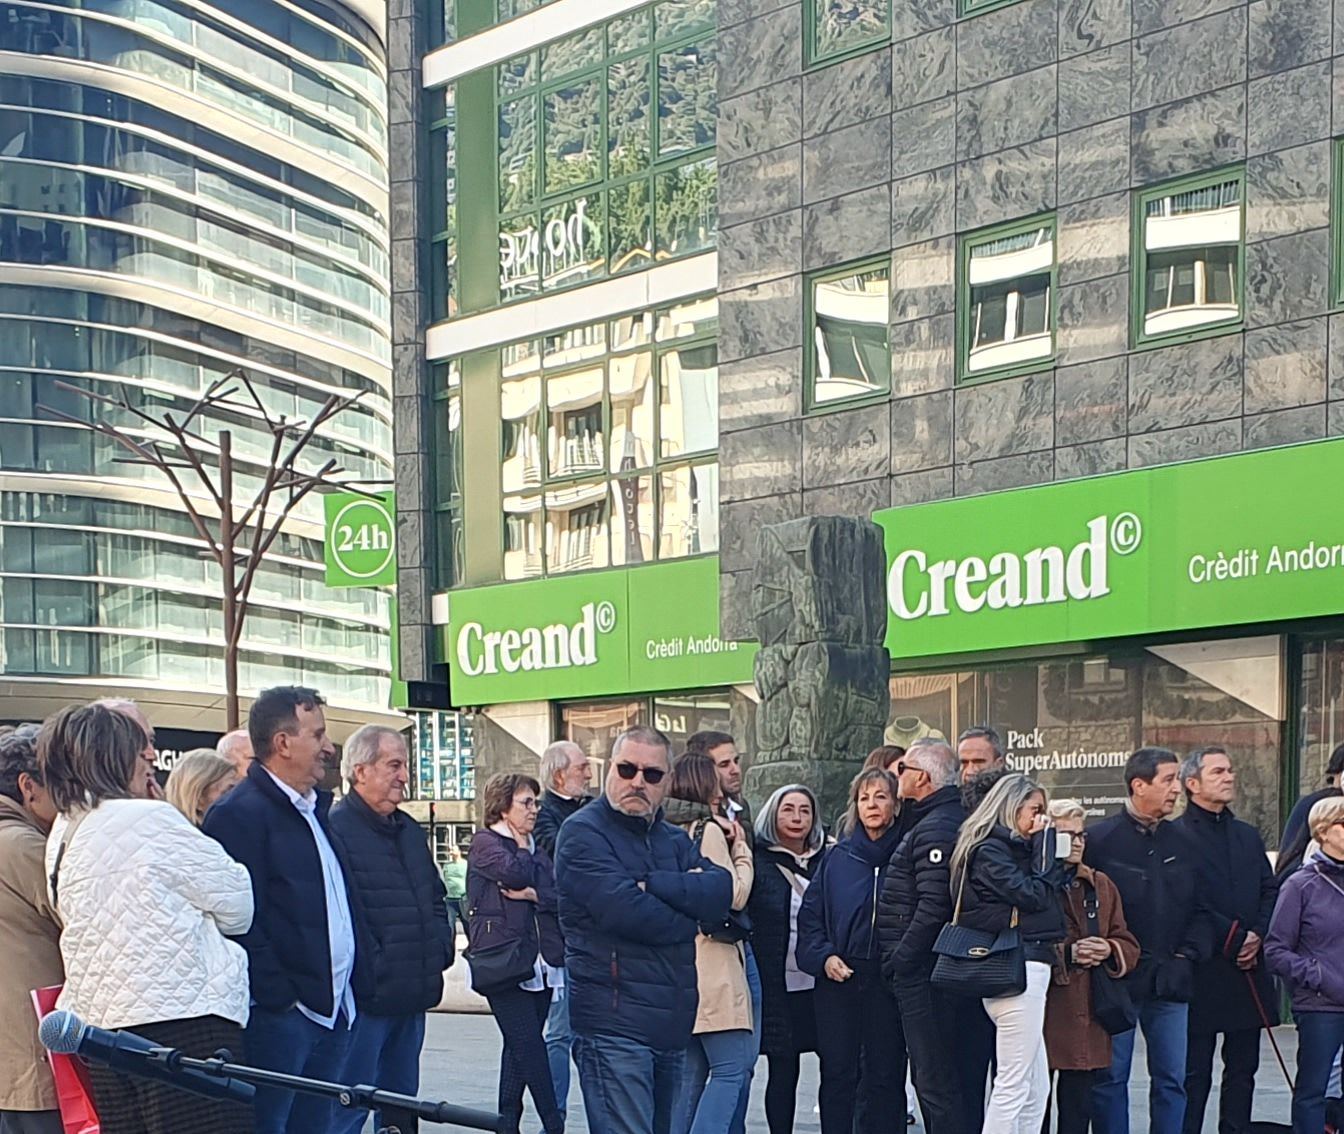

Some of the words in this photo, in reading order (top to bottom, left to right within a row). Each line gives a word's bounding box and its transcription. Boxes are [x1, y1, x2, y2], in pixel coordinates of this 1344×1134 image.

[337, 523, 389, 552] 24h
[1188, 549, 1259, 583] Crèdit
[646, 638, 683, 659] Crèdit
[1006, 727, 1045, 750] Pack
